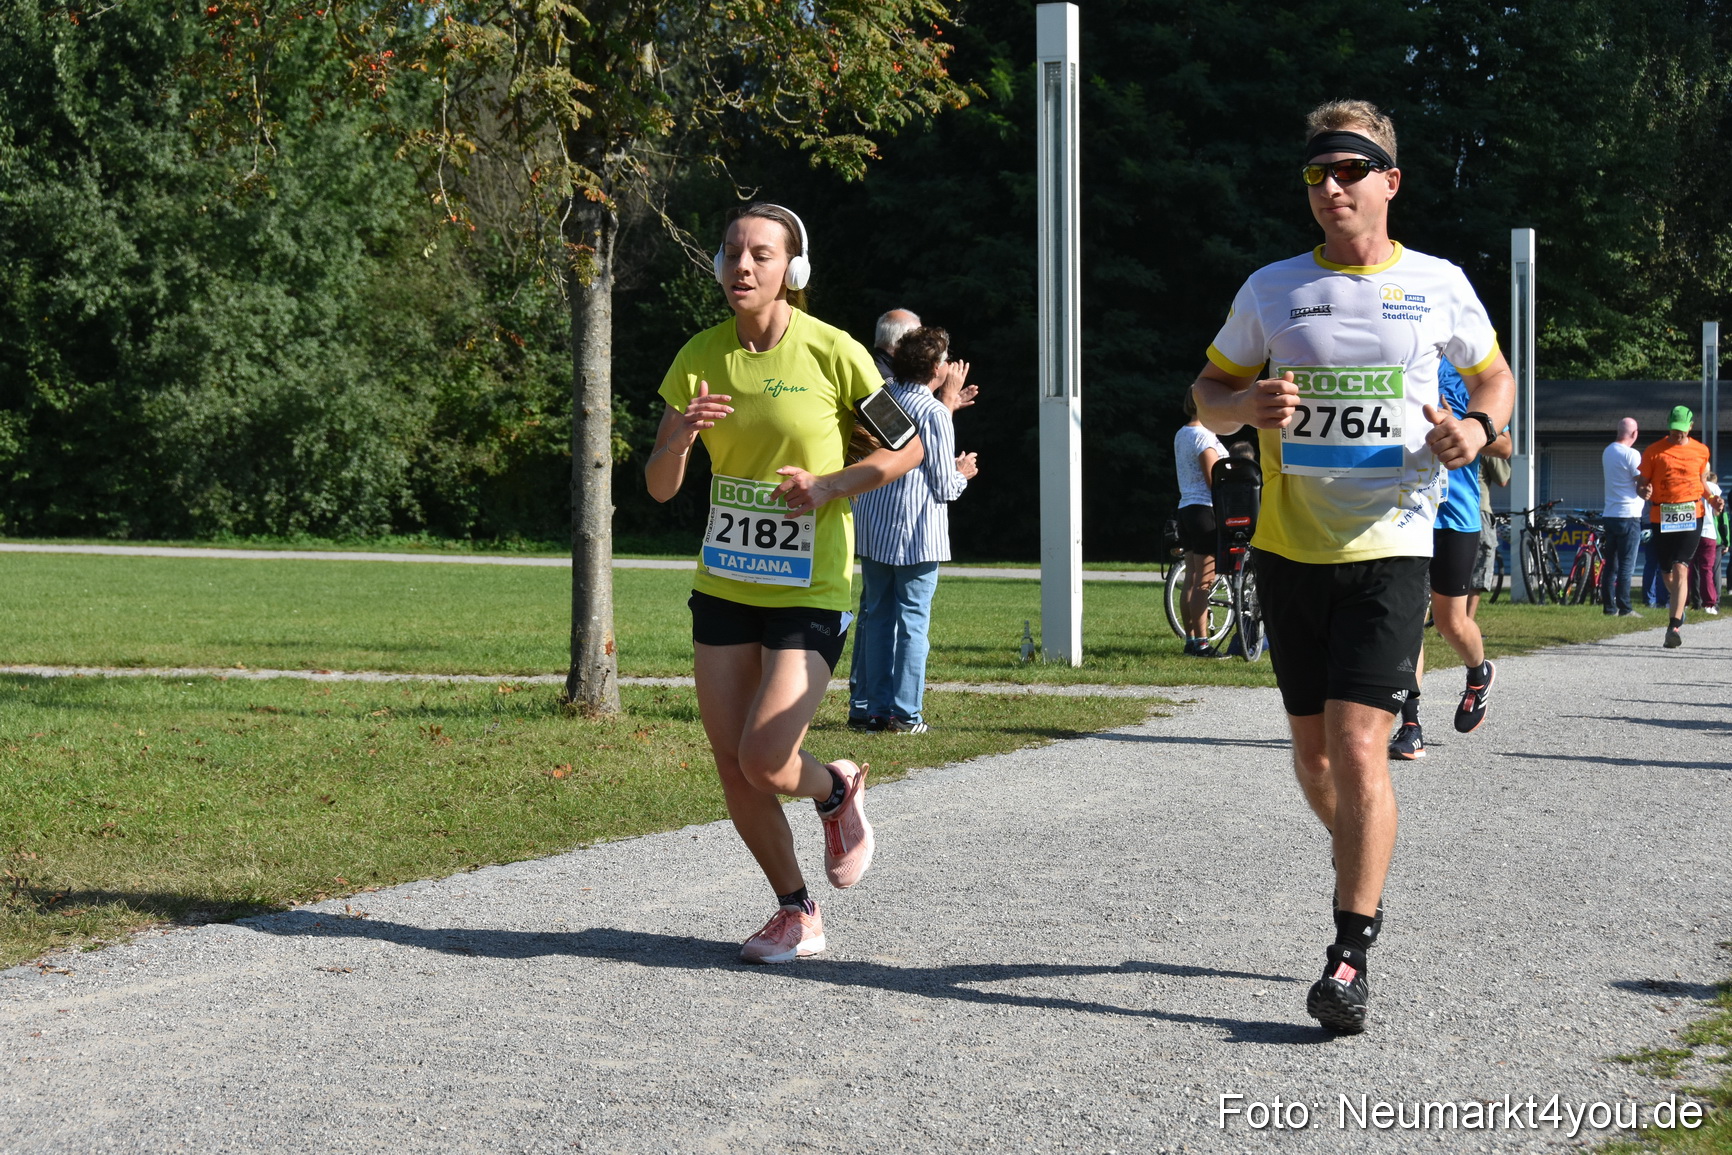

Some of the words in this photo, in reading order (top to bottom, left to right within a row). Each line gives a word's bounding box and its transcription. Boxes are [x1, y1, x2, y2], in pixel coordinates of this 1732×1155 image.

[1382, 287, 1404, 301] 20
[1382, 302, 1431, 313] Neumarkter
[1382, 312, 1423, 322] Stadtlauf
[763, 378, 809, 397] Tatjana
[1292, 370, 1395, 395] BOCK
[1294, 405, 1391, 439] 2764
[1665, 513, 1692, 523] 2609
[716, 513, 799, 551] 2182
[718, 552, 792, 574] TATJANA
